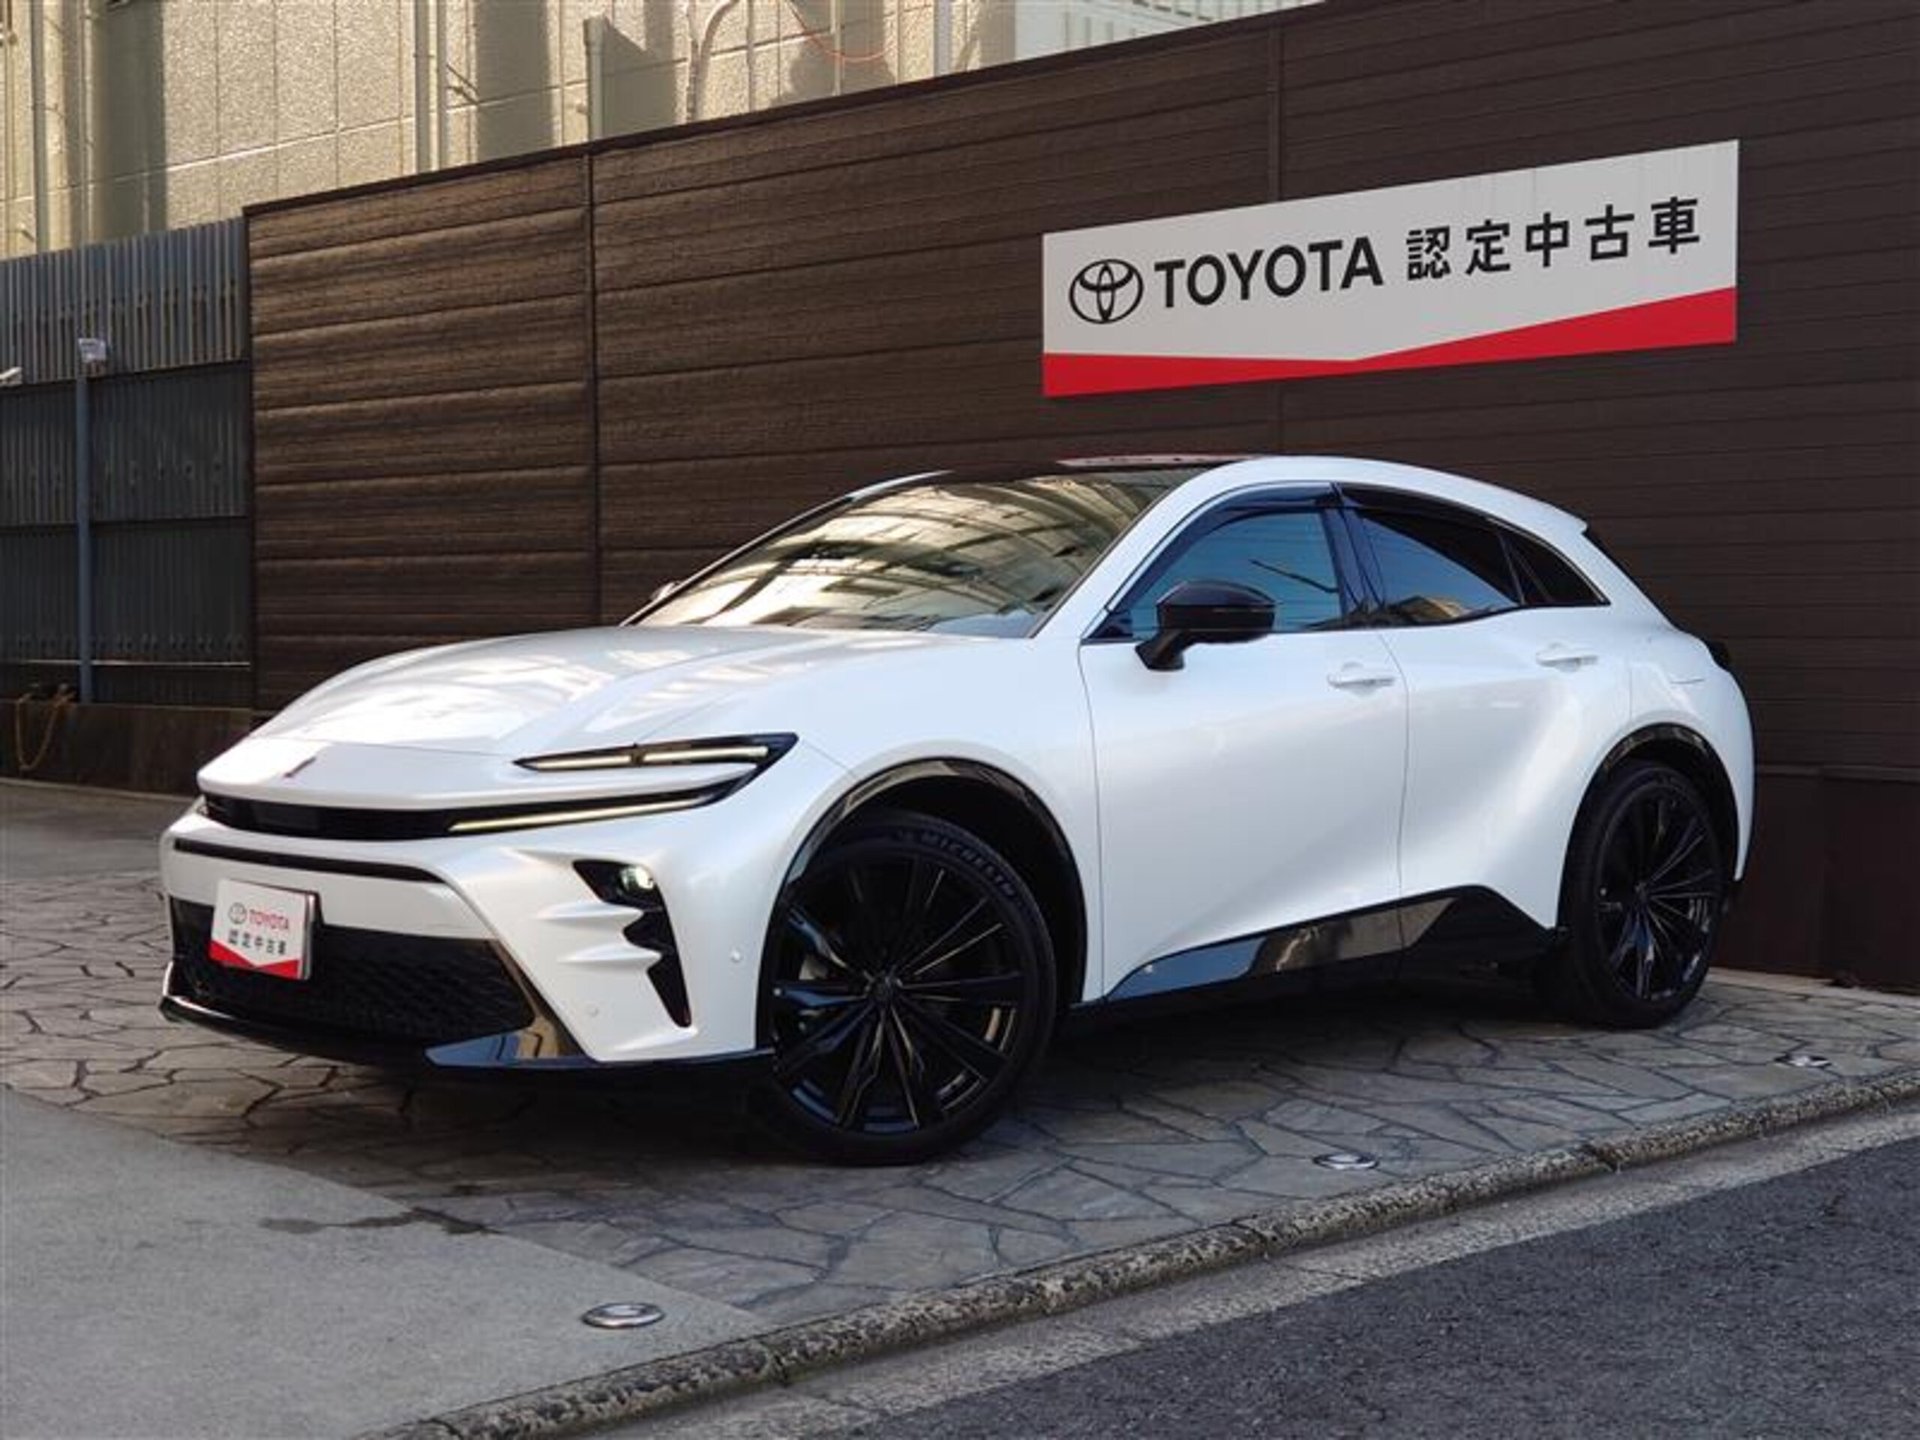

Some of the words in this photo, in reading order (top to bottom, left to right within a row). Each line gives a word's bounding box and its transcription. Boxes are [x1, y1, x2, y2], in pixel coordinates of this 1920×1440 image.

[1153, 235, 1385, 309] TOYOTA
[1405, 195, 1701, 282] 認定中古車
[920, 829, 1016, 897] MICHELIN
[228, 928, 287, 955] 認定中古車
[249, 908, 289, 930] TOYOTA
